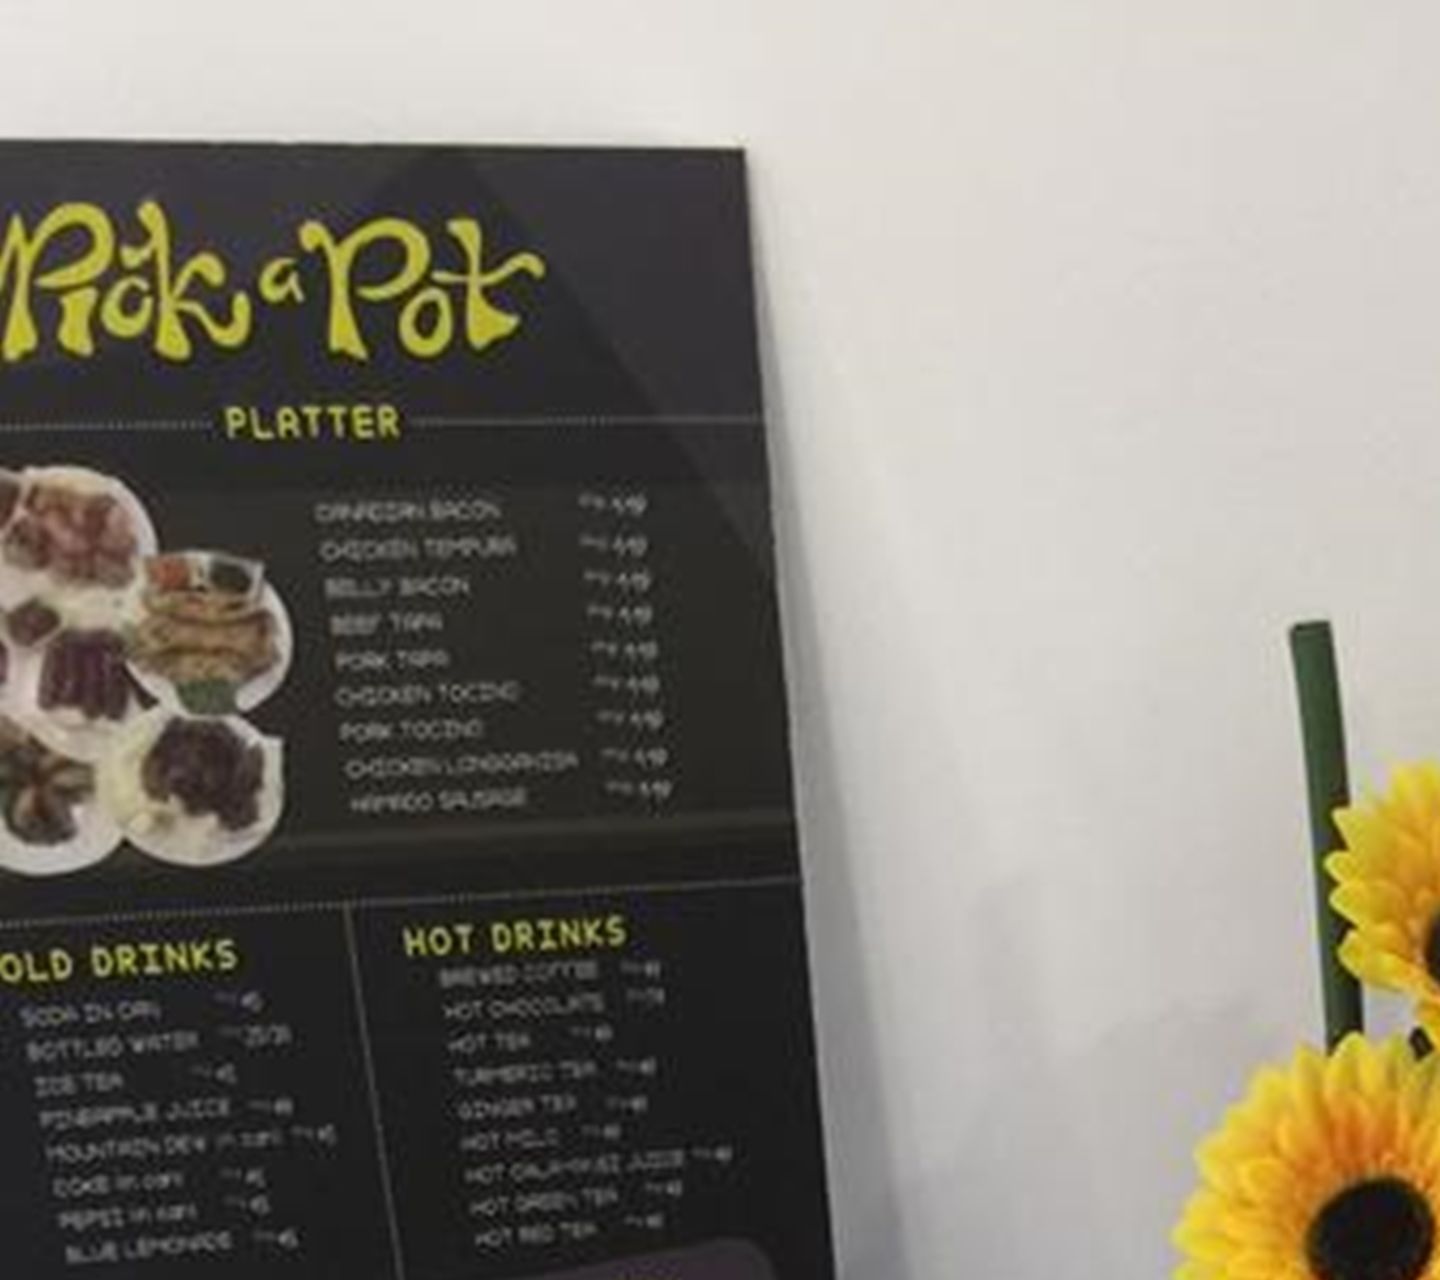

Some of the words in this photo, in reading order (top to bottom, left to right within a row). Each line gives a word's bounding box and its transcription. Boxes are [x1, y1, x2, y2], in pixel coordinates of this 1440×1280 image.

[0, 200, 251, 361] Pick
[258, 257, 304, 303] a
[300, 217, 546, 361] Pot
[225, 405, 401, 439] PLATTER
[403, 922, 474, 957] HOT
[491, 915, 627, 952] DRINKS
[91, 940, 238, 977] DRINKS
